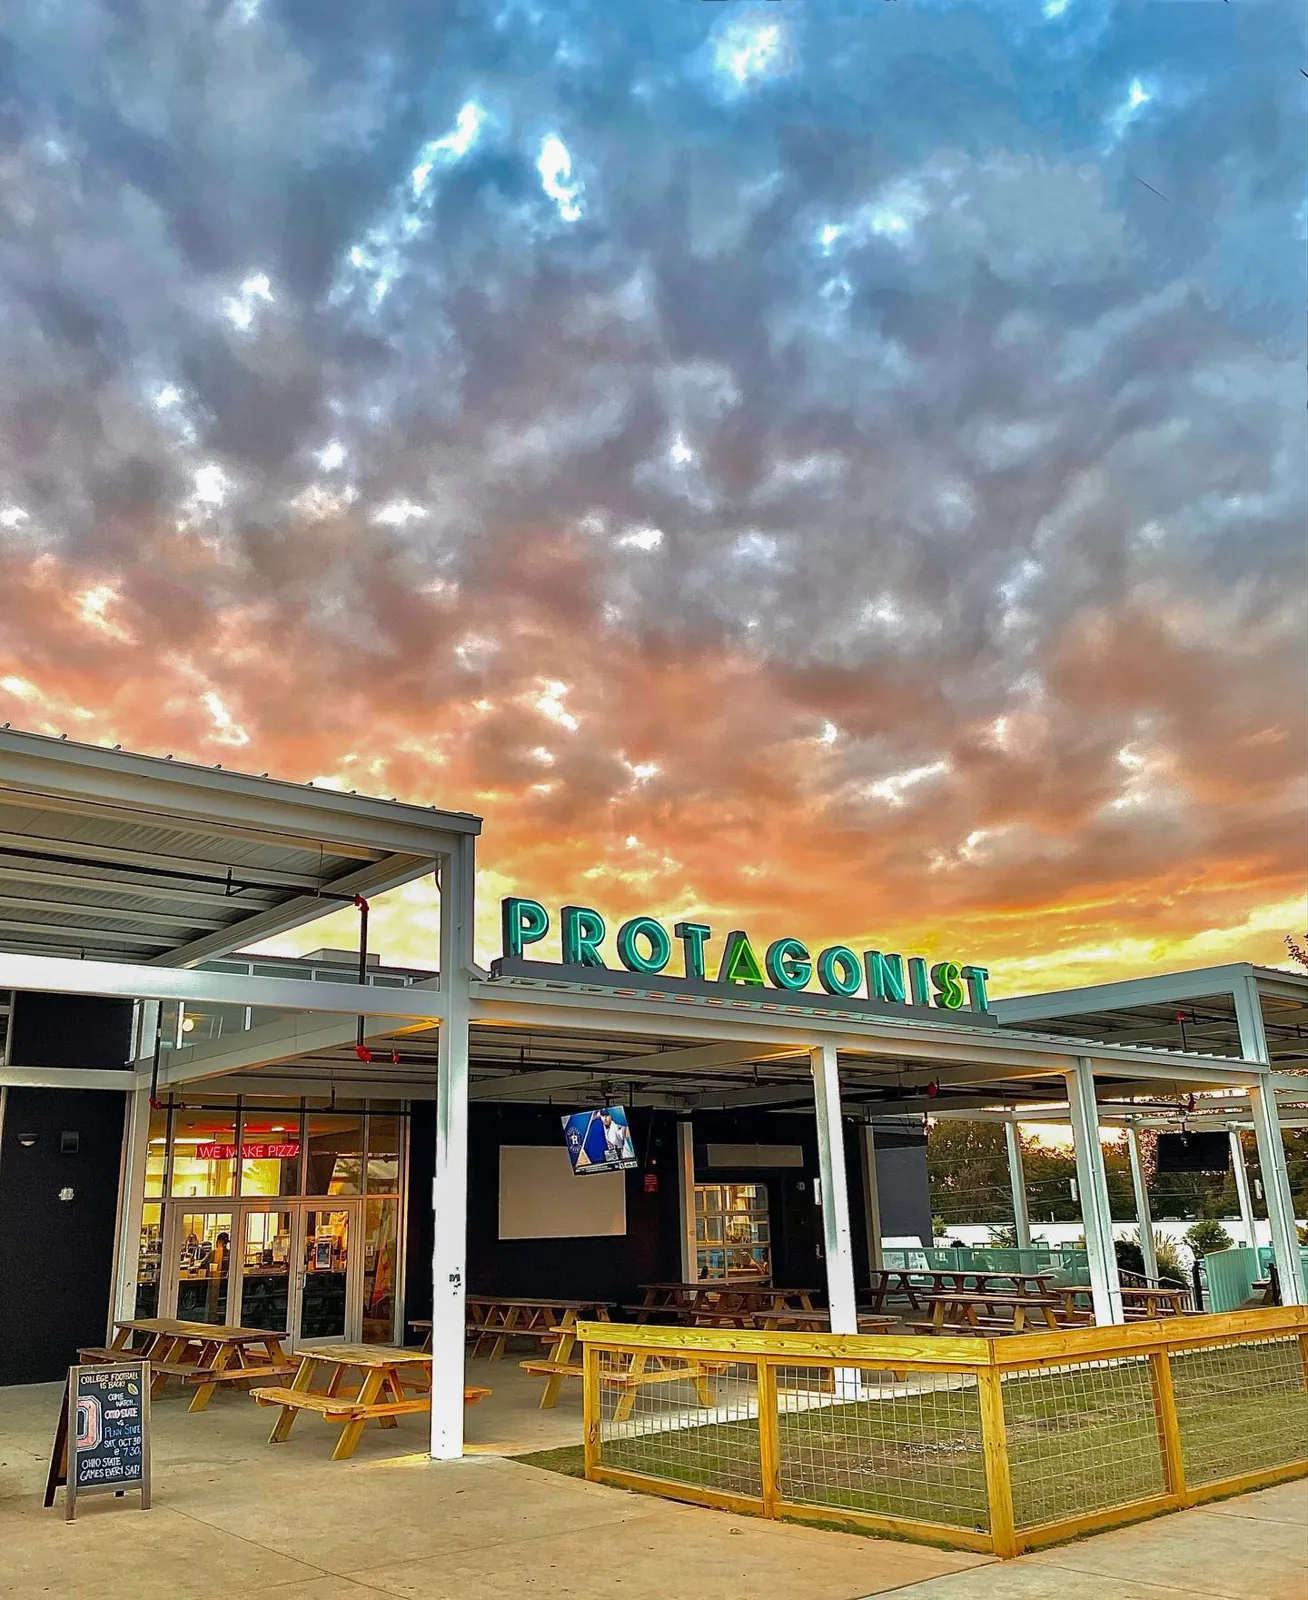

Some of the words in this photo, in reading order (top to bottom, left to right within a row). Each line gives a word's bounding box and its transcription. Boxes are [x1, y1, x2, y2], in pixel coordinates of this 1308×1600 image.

[501, 897, 989, 1013] PROTAGONIST
[200, 1146, 220, 1158] WE
[226, 1146, 263, 1158] MAKE
[268, 1145, 300, 1157] PIZZA
[81, 1375, 109, 1384] COLLEGE
[111, 1372, 138, 1381] FOOTBALL
[108, 1393, 124, 1401] COME
[104, 1409, 120, 1419] OHIO
[121, 1408, 138, 1418] STATE
[118, 1438, 132, 1447] OCT
[82, 1458, 101, 1469] OHIO
[102, 1457, 121, 1467] STATE
[80, 1469, 104, 1481] GAMES
[105, 1466, 123, 1477] EVERY
[125, 1465, 140, 1476] SAT!
